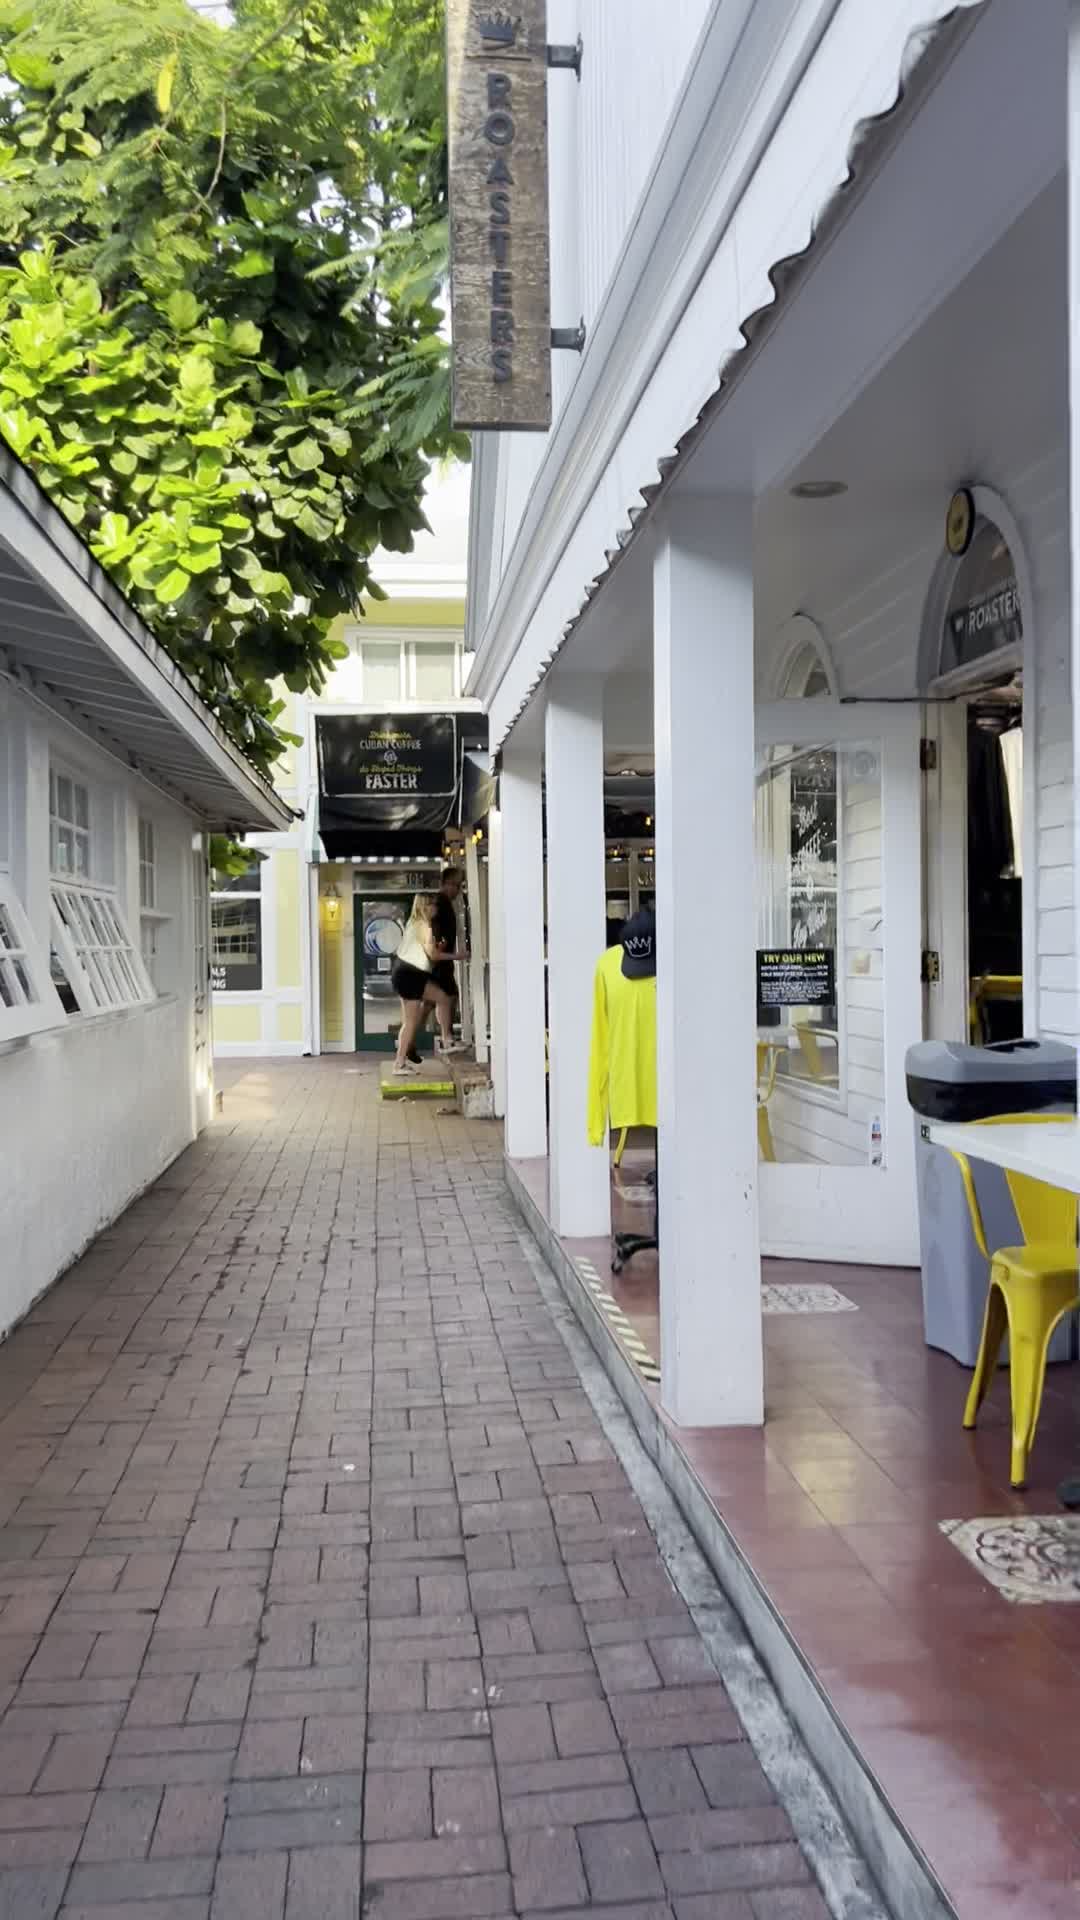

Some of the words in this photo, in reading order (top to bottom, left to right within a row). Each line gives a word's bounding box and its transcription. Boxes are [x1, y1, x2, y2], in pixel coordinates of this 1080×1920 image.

[483, 72, 514, 385] ROASTERS
[365, 774, 418, 789] FASTER
[763, 953, 780, 964] TRY
[782, 953, 802, 963] OUR
[804, 953, 825, 963] NEW
